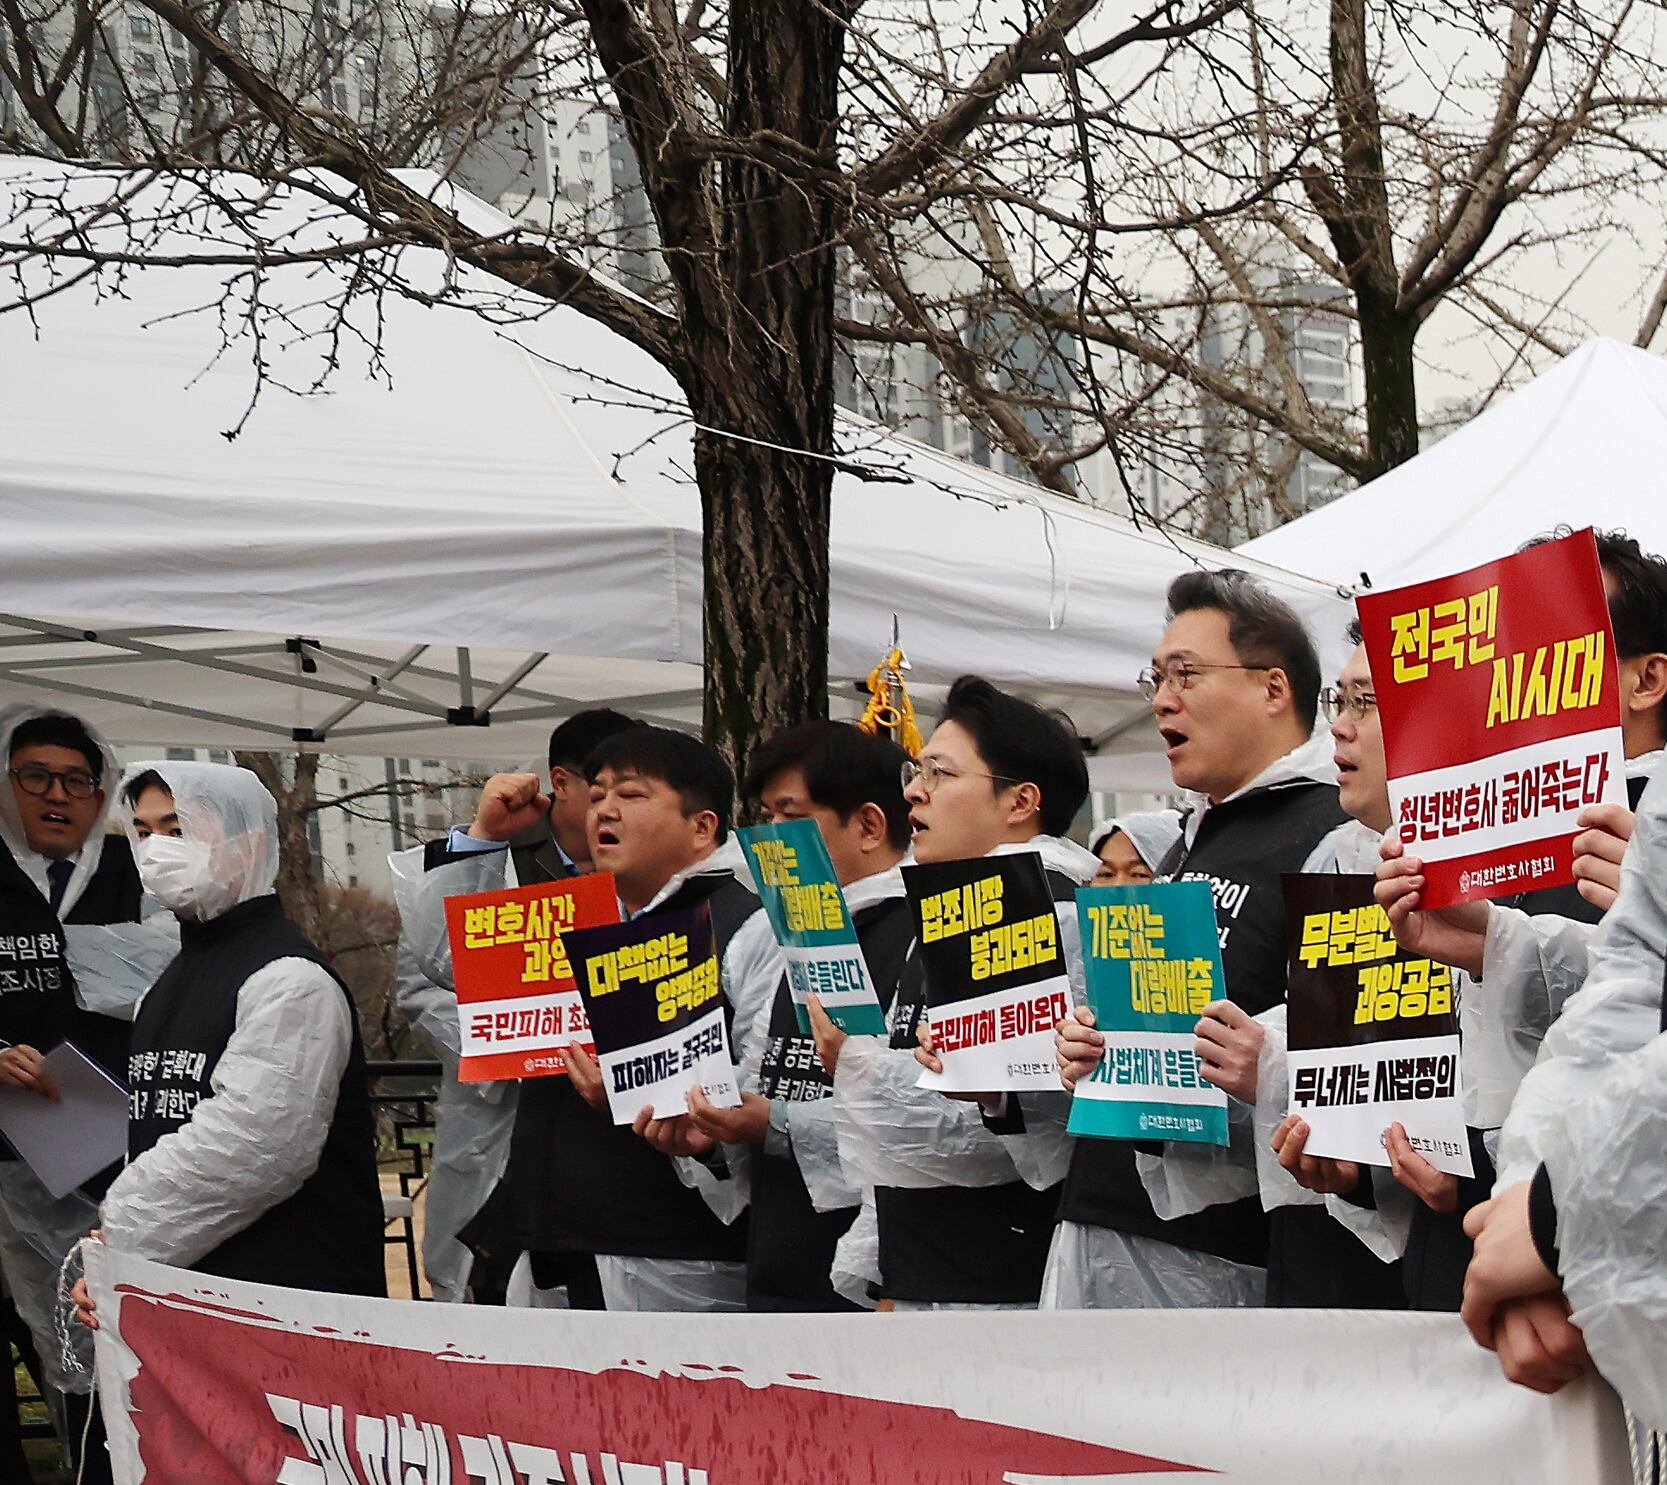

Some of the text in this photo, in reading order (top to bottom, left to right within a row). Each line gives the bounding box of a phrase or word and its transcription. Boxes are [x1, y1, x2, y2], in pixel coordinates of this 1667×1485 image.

[1391, 585, 1499, 683] 전국민
[1486, 630, 1605, 728] AI시대
[1399, 778, 1497, 843] 청년변호사
[1502, 751, 1609, 824] 굶어죽는다
[1471, 856, 1554, 886] 대한변호사협회
[464, 893, 576, 949] 변호사간
[920, 875, 1004, 943] 법조시장
[1087, 904, 1165, 959] 기준없는
[1299, 903, 1397, 969] 무분별한
[585, 932, 688, 997] 대책없는
[970, 913, 1057, 981] 붕괴되면
[1130, 957, 1213, 1015] 대량배출
[1354, 958, 1451, 1025] 과잉공급
[471, 1006, 562, 1042] 국민피해
[930, 1005, 996, 1054] 국민피해
[1000, 991, 1067, 1041] 돌아온다
[611, 1048, 679, 1094] 피해자는
[1294, 1054, 1457, 1107] 무너지는 사법정의
